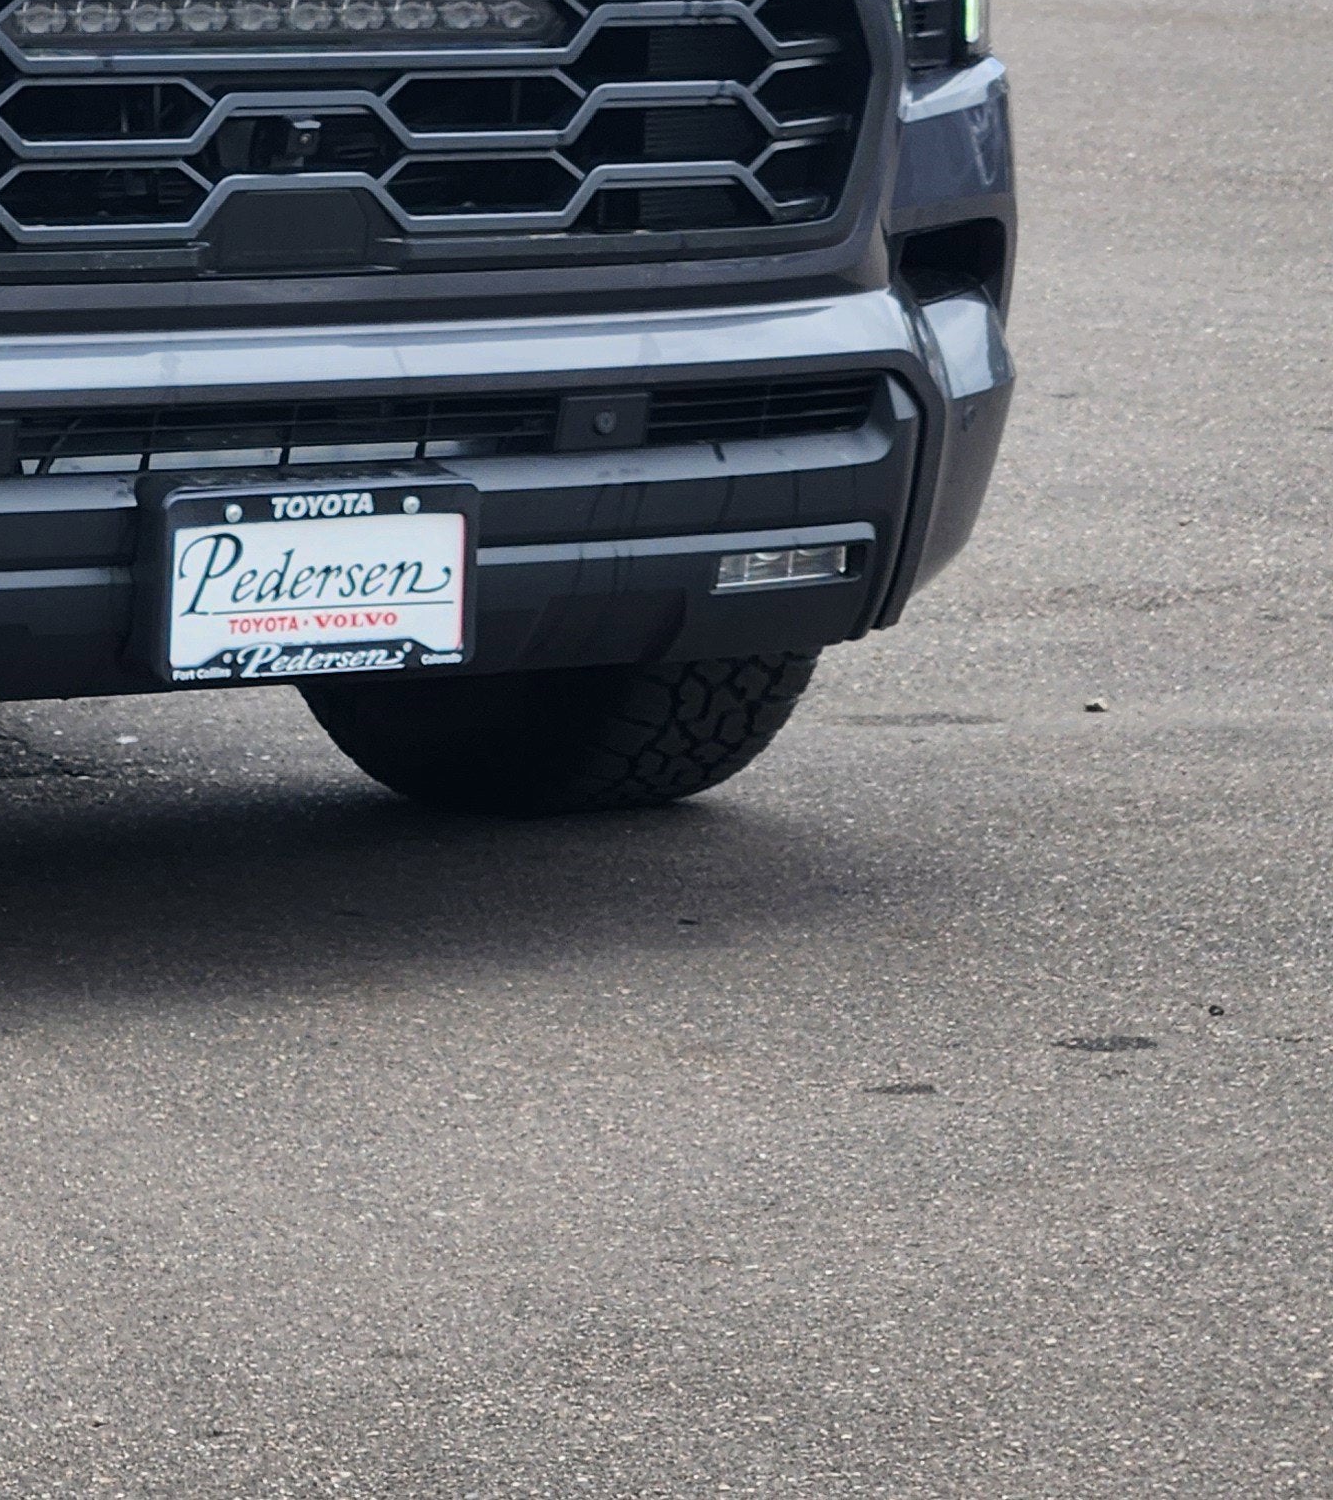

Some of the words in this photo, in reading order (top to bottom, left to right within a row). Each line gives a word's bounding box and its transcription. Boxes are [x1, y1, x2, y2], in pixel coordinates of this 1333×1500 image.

[271, 492, 374, 519] TOYOTA
[179, 532, 452, 616] Pedersen
[229, 616, 299, 634] TOYOTA
[314, 612, 398, 628] VOLVO
[236, 643, 406, 678] Pedersen
